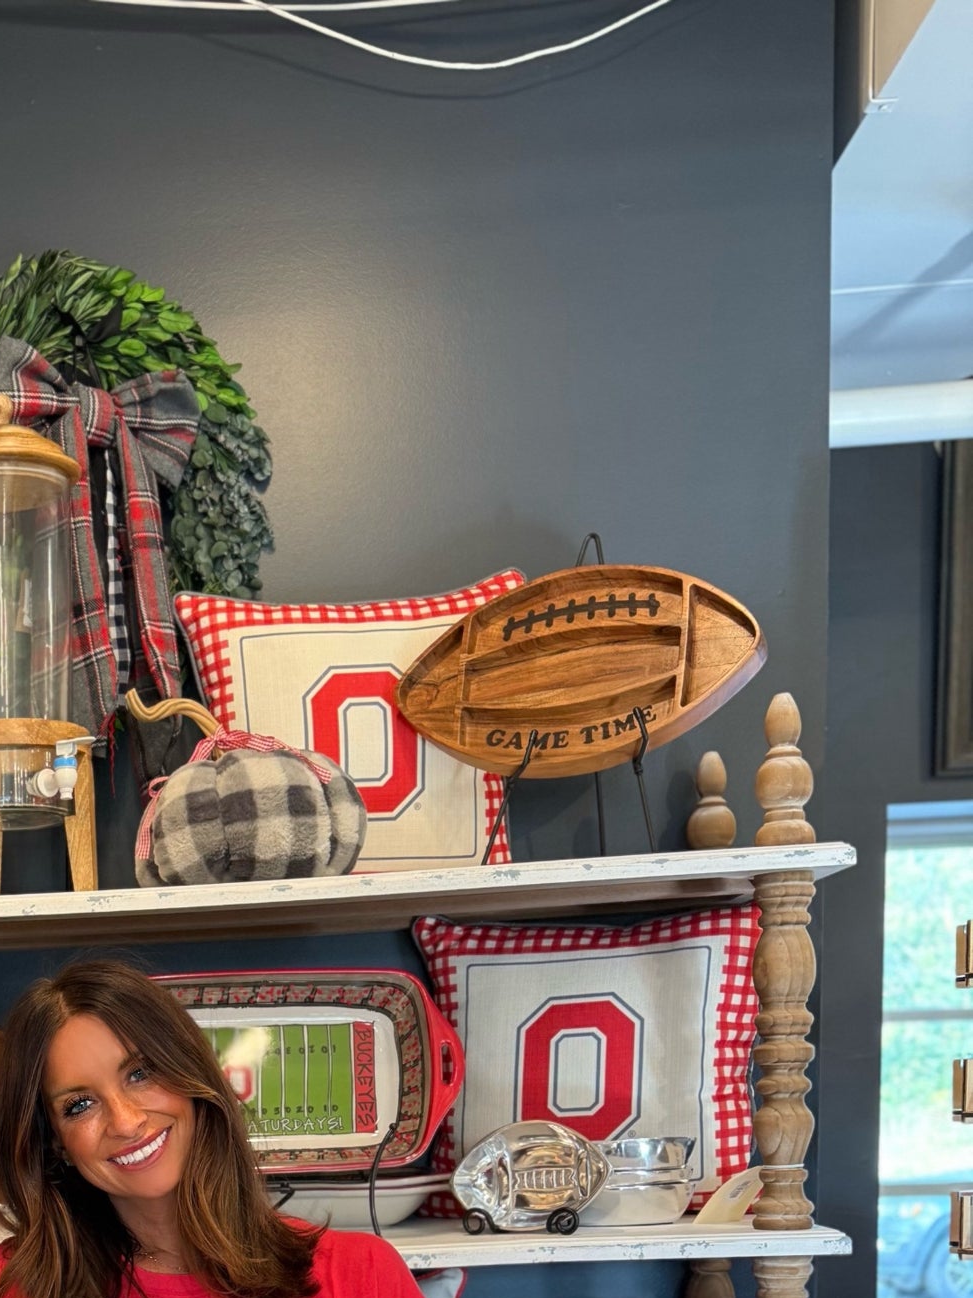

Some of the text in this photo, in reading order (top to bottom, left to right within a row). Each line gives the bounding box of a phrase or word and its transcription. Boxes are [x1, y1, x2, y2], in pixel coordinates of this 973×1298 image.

[303, 664, 426, 820] O
[486, 705, 657, 750] GAME TIME
[355, 1028, 376, 1127] BUCKEYES
[513, 992, 644, 1142] O
[247, 1116, 344, 1132] ATURDAYS!
